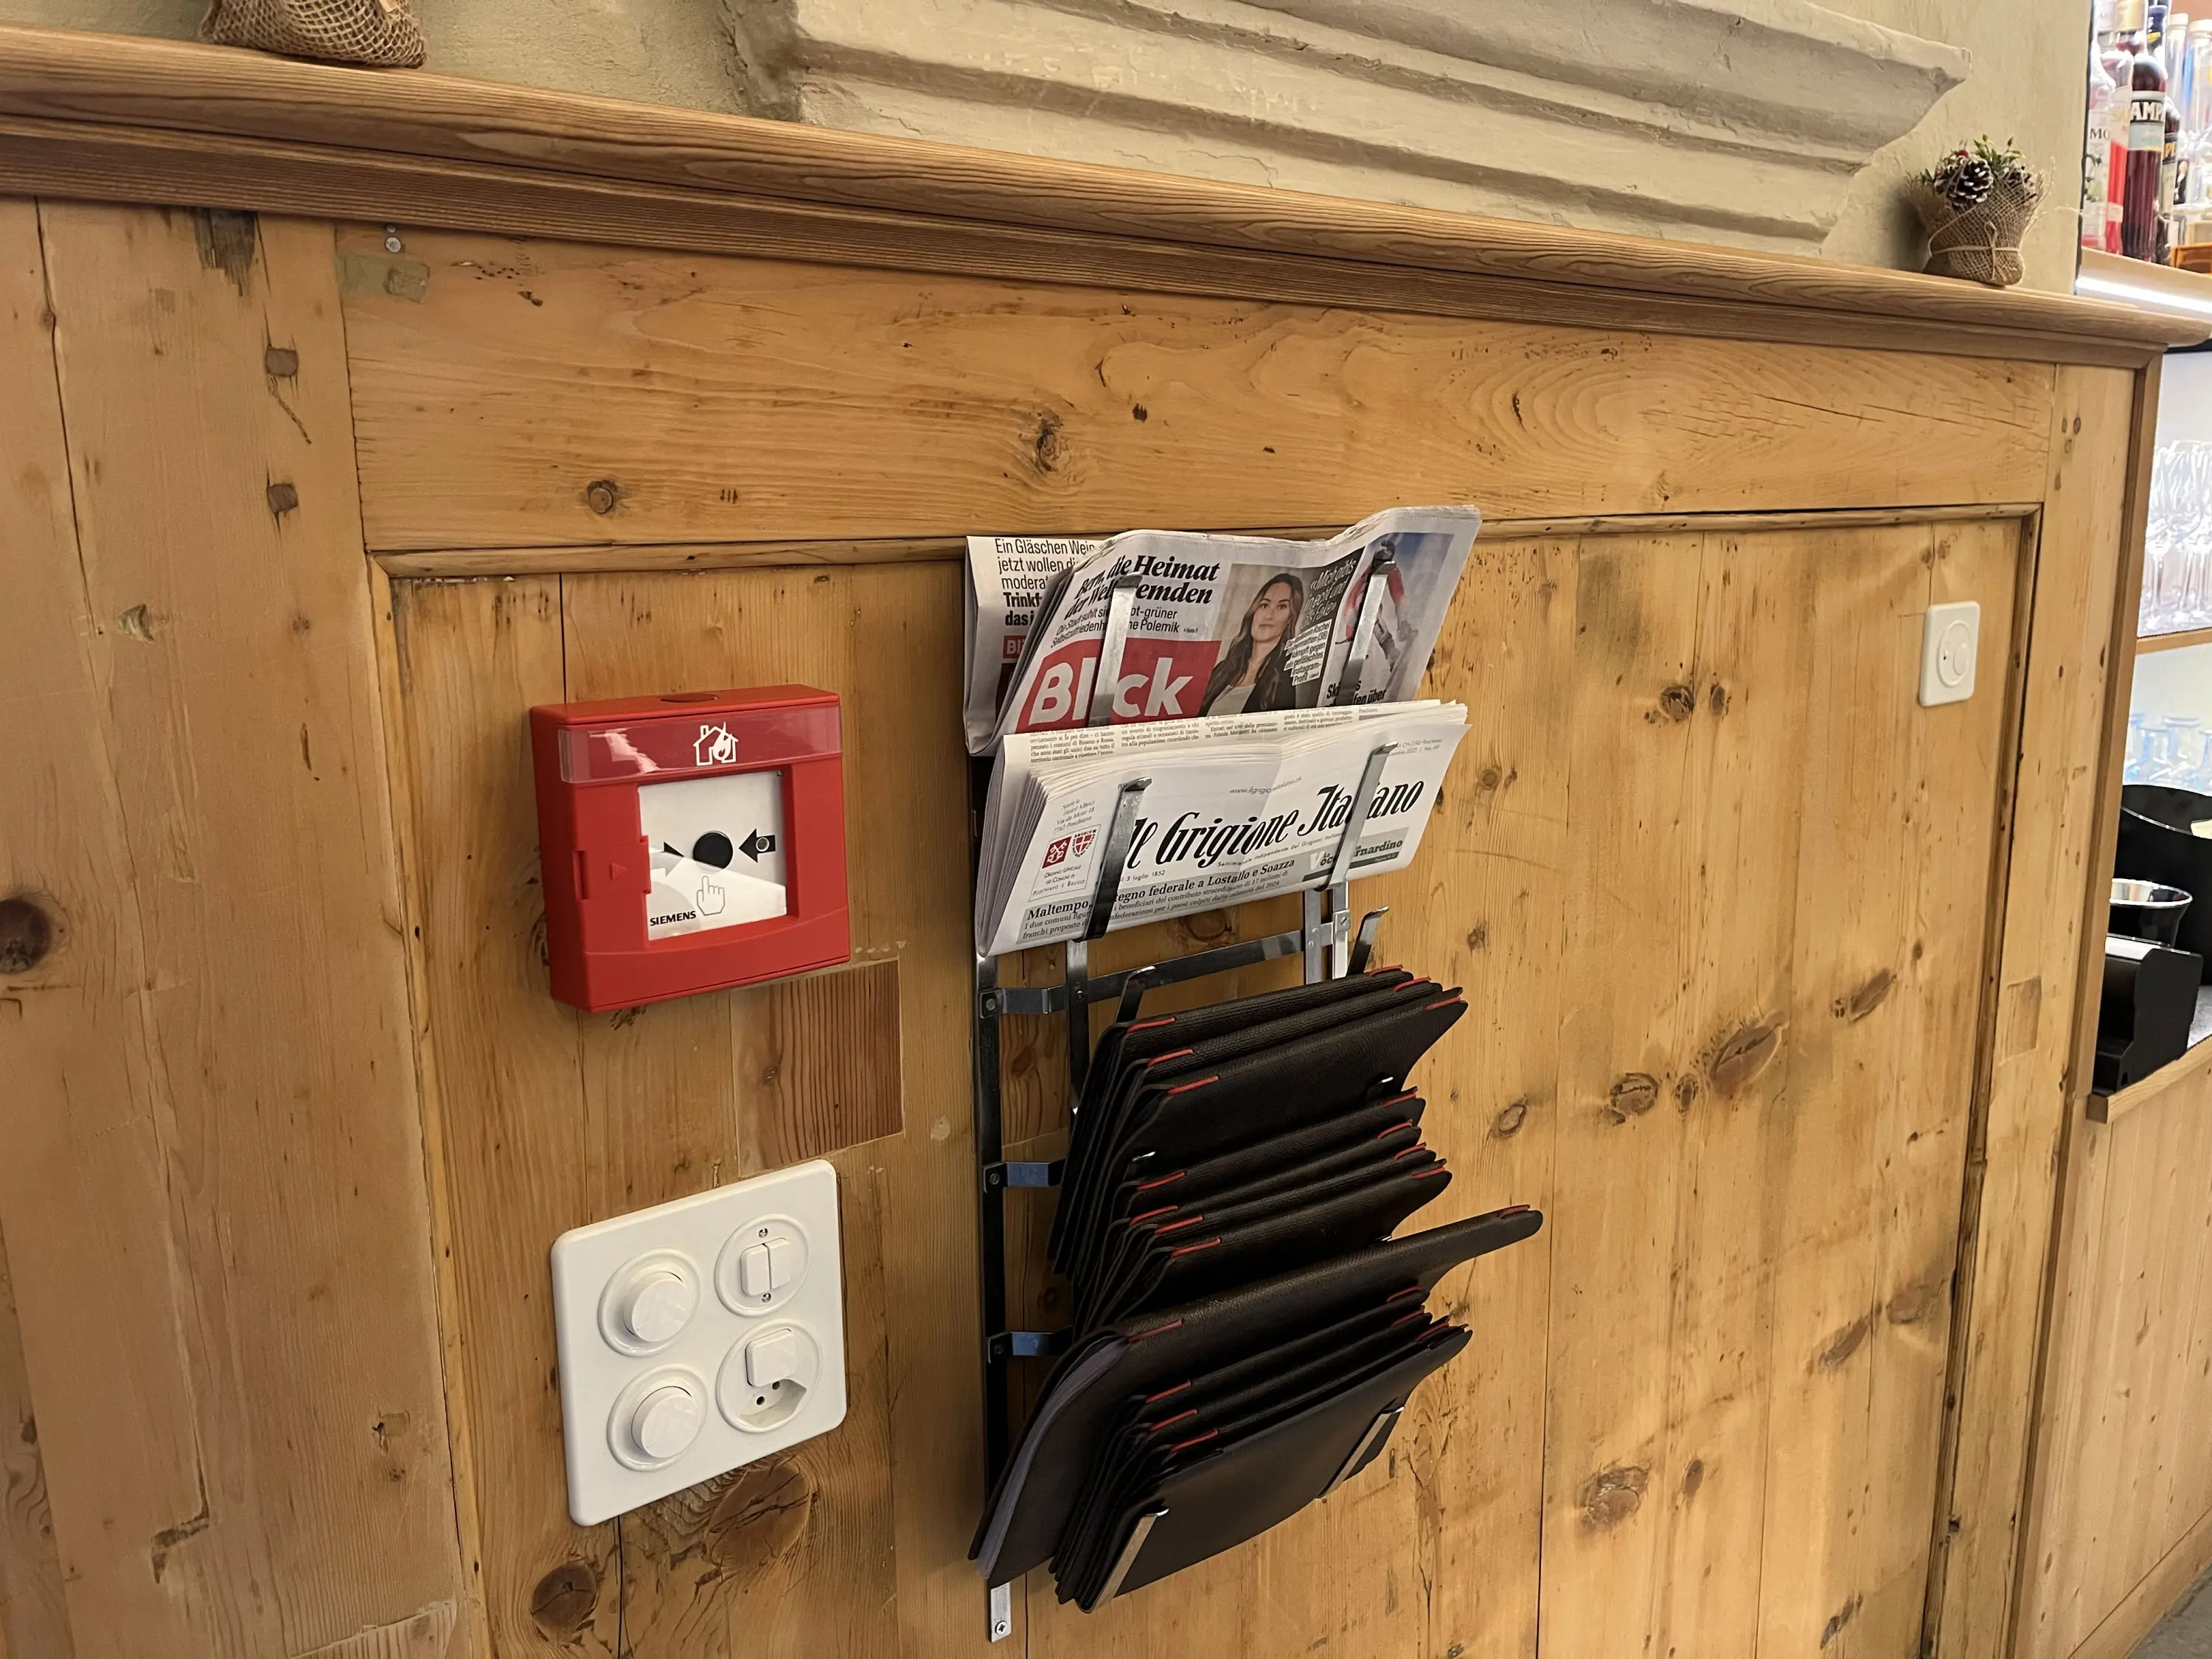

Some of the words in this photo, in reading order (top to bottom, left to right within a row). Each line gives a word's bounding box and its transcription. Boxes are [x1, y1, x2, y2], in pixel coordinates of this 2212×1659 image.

[2130, 102, 2165, 122] AMP
[995, 538, 1013, 553] Ein
[1015, 539, 1068, 554] Gläschen
[998, 557, 1026, 574] jetzt
[1026, 557, 1064, 572] wollen
[1066, 557, 1079, 568] di
[1001, 574, 1048, 589] modera
[1074, 570, 1105, 599] Bern,
[1107, 554, 1132, 580] die
[1133, 554, 1220, 581] Heimat
[1003, 592, 1042, 607] Trinkf
[1064, 595, 1090, 620] der
[1005, 611, 1028, 625] das
[1098, 606, 1110, 618] si
[1131, 605, 1178, 620] ot-grüner
[1141, 619, 1180, 633] Polemik
[1006, 639, 1025, 655] Bl
[1029, 657, 1193, 726] Blck
[1368, 688, 1387, 704] über
[1155, 809, 1300, 869] Grigione
[1298, 781, 1424, 836] Itaano
[1133, 873, 1149, 881] luglio
[1027, 900, 1093, 920] Maltempo,
[1149, 880, 1194, 897] federale
[1197, 880, 1204, 888] a
[1207, 871, 1250, 886] Lostallo
[1260, 859, 1295, 874] Soazza
[1045, 916, 1071, 925] comuni
[1073, 911, 1091, 920] figur
[1119, 899, 1155, 911] beneficiari
[1155, 896, 1166, 904] del
[1167, 890, 1202, 902] contributo
[650, 911, 696, 926] SIEMENS
[1023, 928, 1048, 939] franchi
[1049, 922, 1080, 935] proposto
[1110, 908, 1153, 920] nfederazione
[1154, 905, 1166, 914] per
[1189, 897, 1211, 907] colpiti
